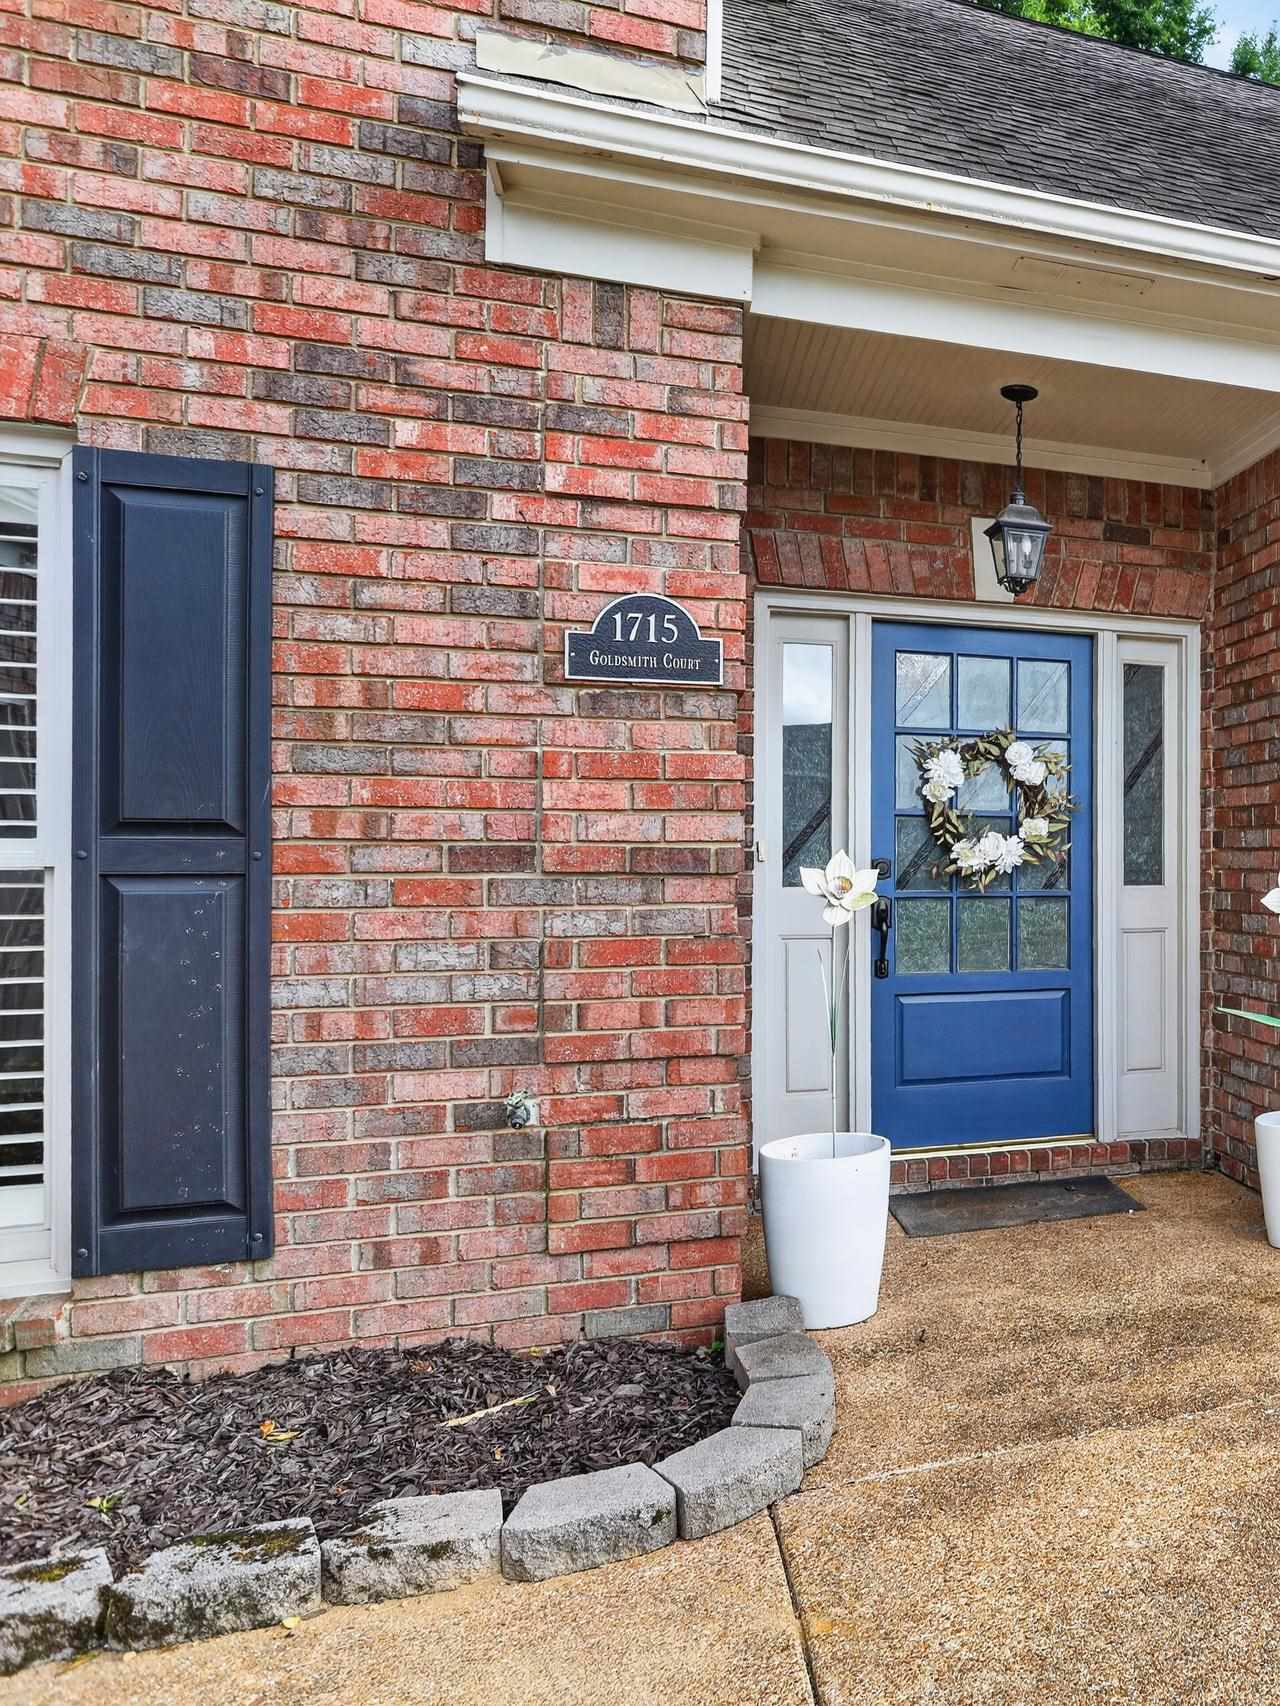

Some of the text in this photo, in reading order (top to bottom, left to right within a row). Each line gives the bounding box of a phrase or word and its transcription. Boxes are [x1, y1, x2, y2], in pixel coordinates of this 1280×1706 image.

[611, 611, 679, 643] 1715
[589, 649, 701, 670] GOLDSMITH COURT
